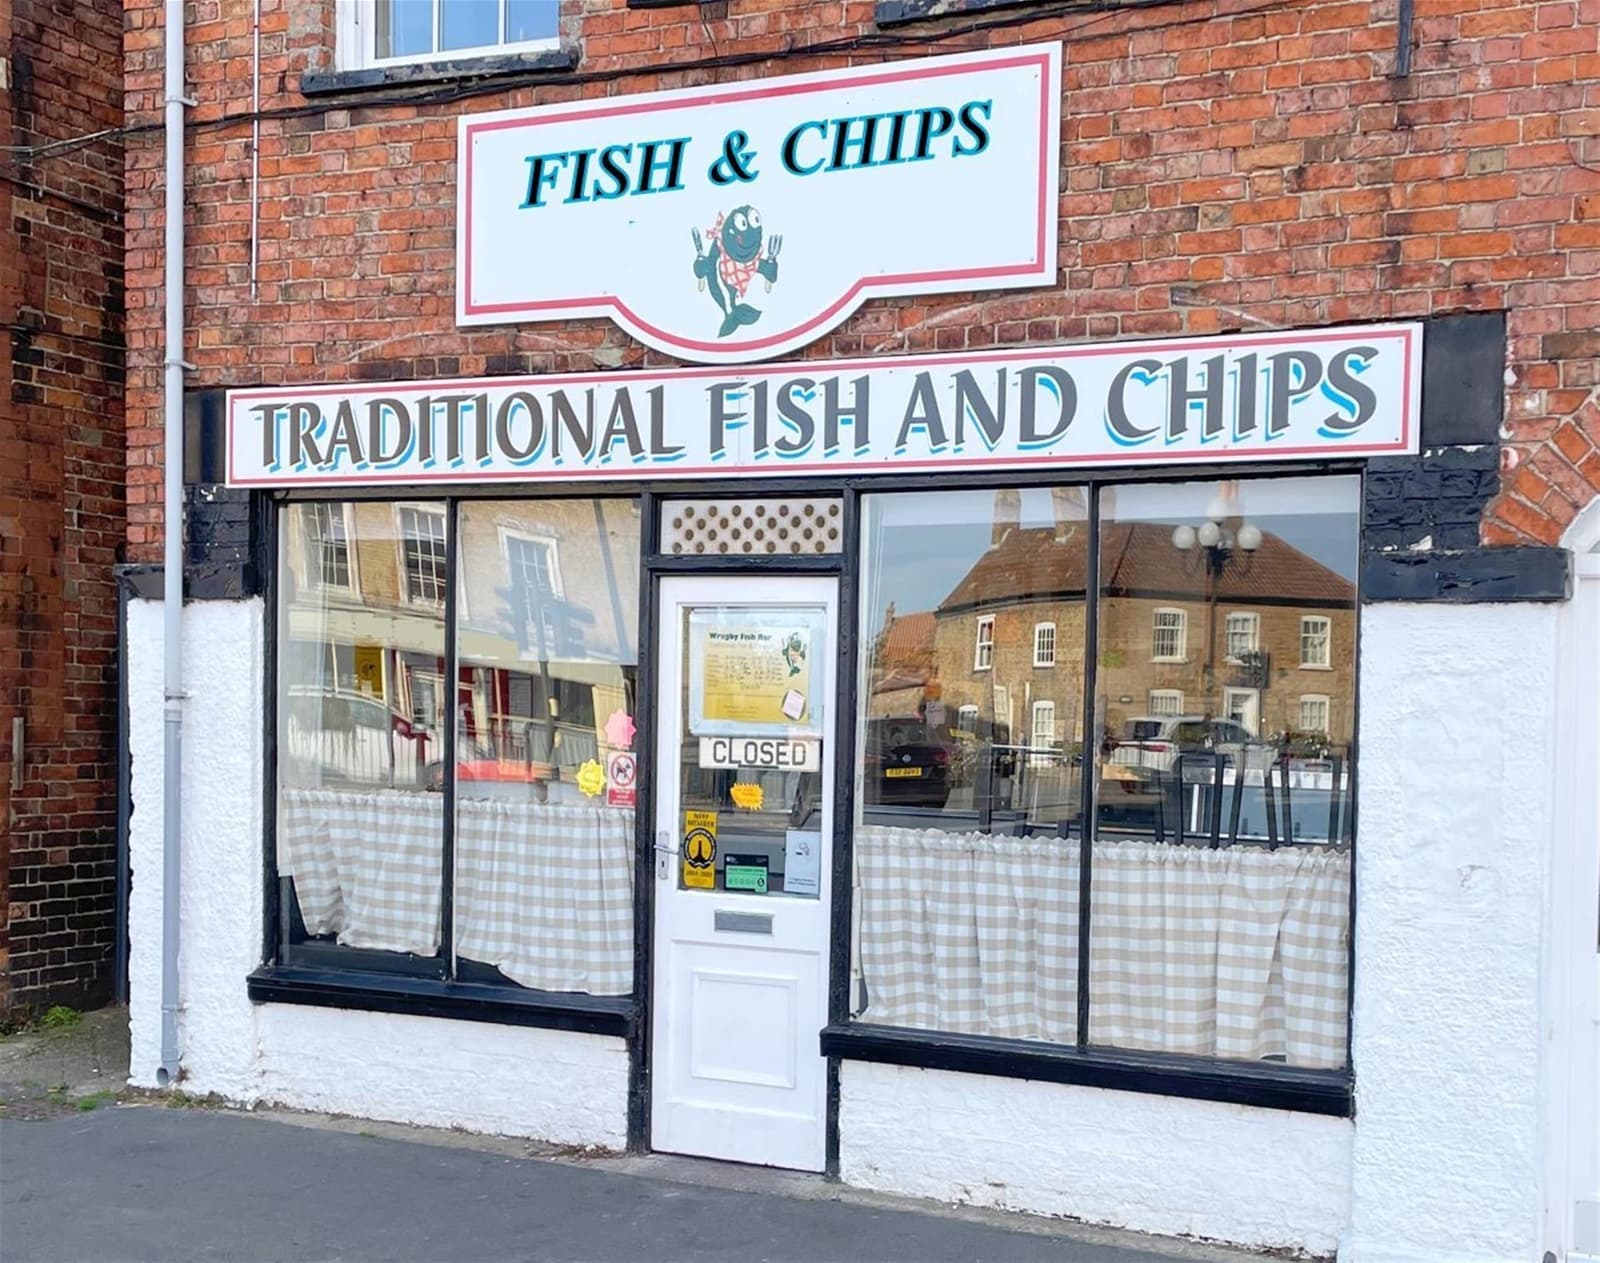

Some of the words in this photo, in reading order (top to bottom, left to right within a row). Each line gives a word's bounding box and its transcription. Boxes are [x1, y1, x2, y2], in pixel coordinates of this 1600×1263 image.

[518, 136, 693, 210] FISH
[707, 129, 760, 186] &
[780, 99, 993, 177] CHIPS
[248, 385, 686, 473] TRADITIONAL
[705, 374, 871, 462] FISH
[894, 365, 1078, 456] AND
[1103, 345, 1380, 447] CHIPS
[712, 738, 807, 767] CLOSED
